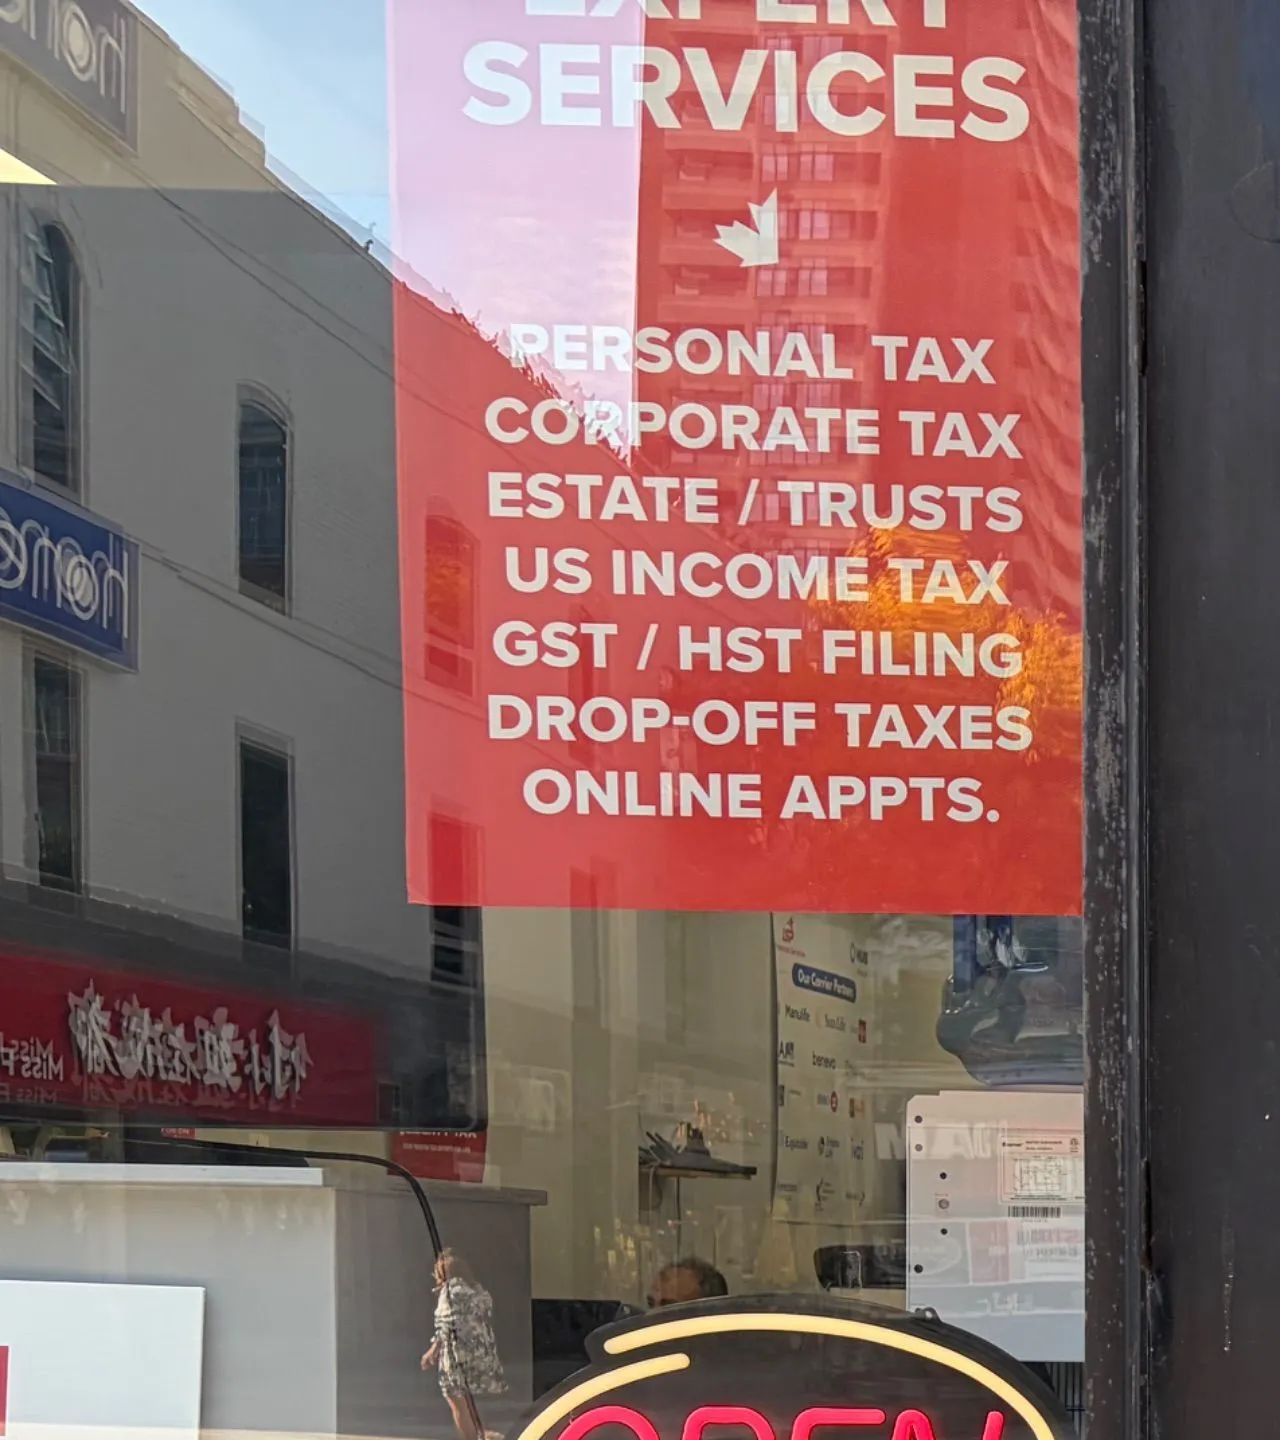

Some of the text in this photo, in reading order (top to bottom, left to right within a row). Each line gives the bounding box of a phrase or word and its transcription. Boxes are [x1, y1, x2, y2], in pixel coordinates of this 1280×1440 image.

[461, 41, 1030, 142] SERVICES
[508, 323, 997, 385] PERSONAL TAX
[484, 396, 1023, 460] CORPORATE TAX
[487, 471, 1023, 534] ESTATE / TRUSTS
[505, 546, 1010, 606] US INCOME TAX
[492, 621, 1023, 679] GST / HST FILING
[488, 694, 1033, 752] DROP-OFF TAXES
[522, 768, 1001, 824] ONLINE APPTS.
